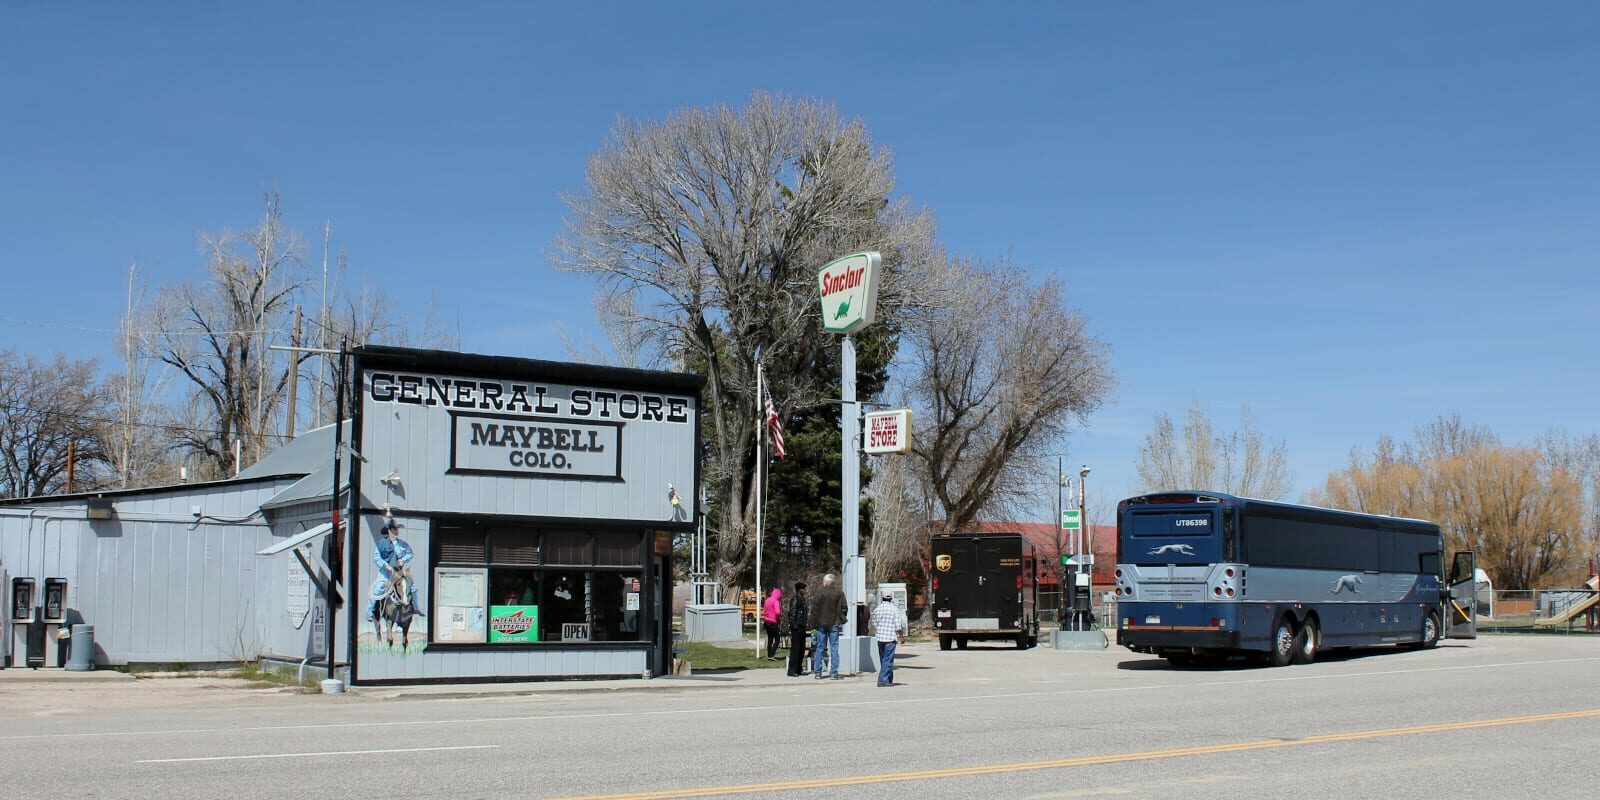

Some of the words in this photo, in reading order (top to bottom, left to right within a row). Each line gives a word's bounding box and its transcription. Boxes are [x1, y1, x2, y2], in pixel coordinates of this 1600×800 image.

[821, 266, 865, 297] Sinclair
[370, 372, 559, 415] GENERAL
[570, 388, 689, 423] STORE
[871, 416, 898, 430] MAYBELL
[470, 422, 604, 453] MAYBELL
[870, 430, 898, 447] STORE
[509, 451, 572, 470] COLO.
[1063, 515, 1079, 524] Diesel
[1175, 519, 1208, 527] UT86398
[937, 559, 951, 570] ups
[492, 617, 535, 625] INTERSTATE
[563, 625, 589, 639] OPEN
